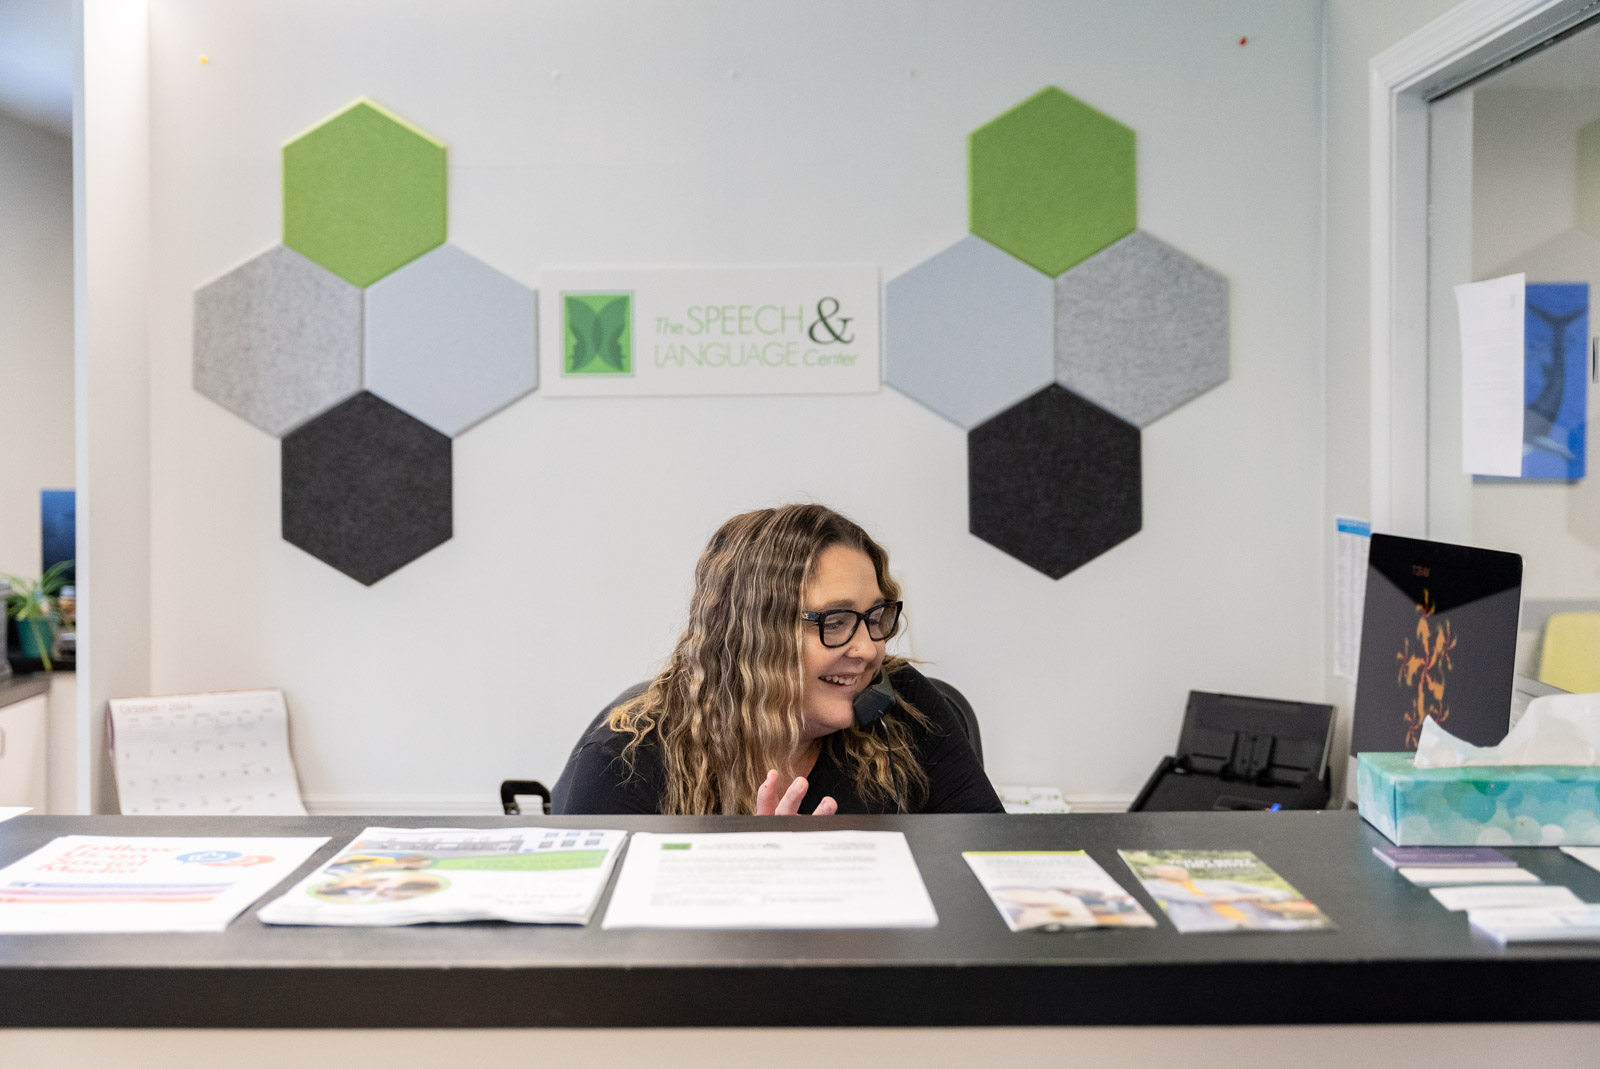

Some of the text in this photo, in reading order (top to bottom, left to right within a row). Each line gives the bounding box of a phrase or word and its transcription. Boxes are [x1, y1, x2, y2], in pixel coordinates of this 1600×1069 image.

[655, 296, 856, 345] The SPEECH &
[654, 342, 858, 367] LANGUAGE Center
[75, 844, 176, 852] Follow
[36, 865, 139, 873] Media
